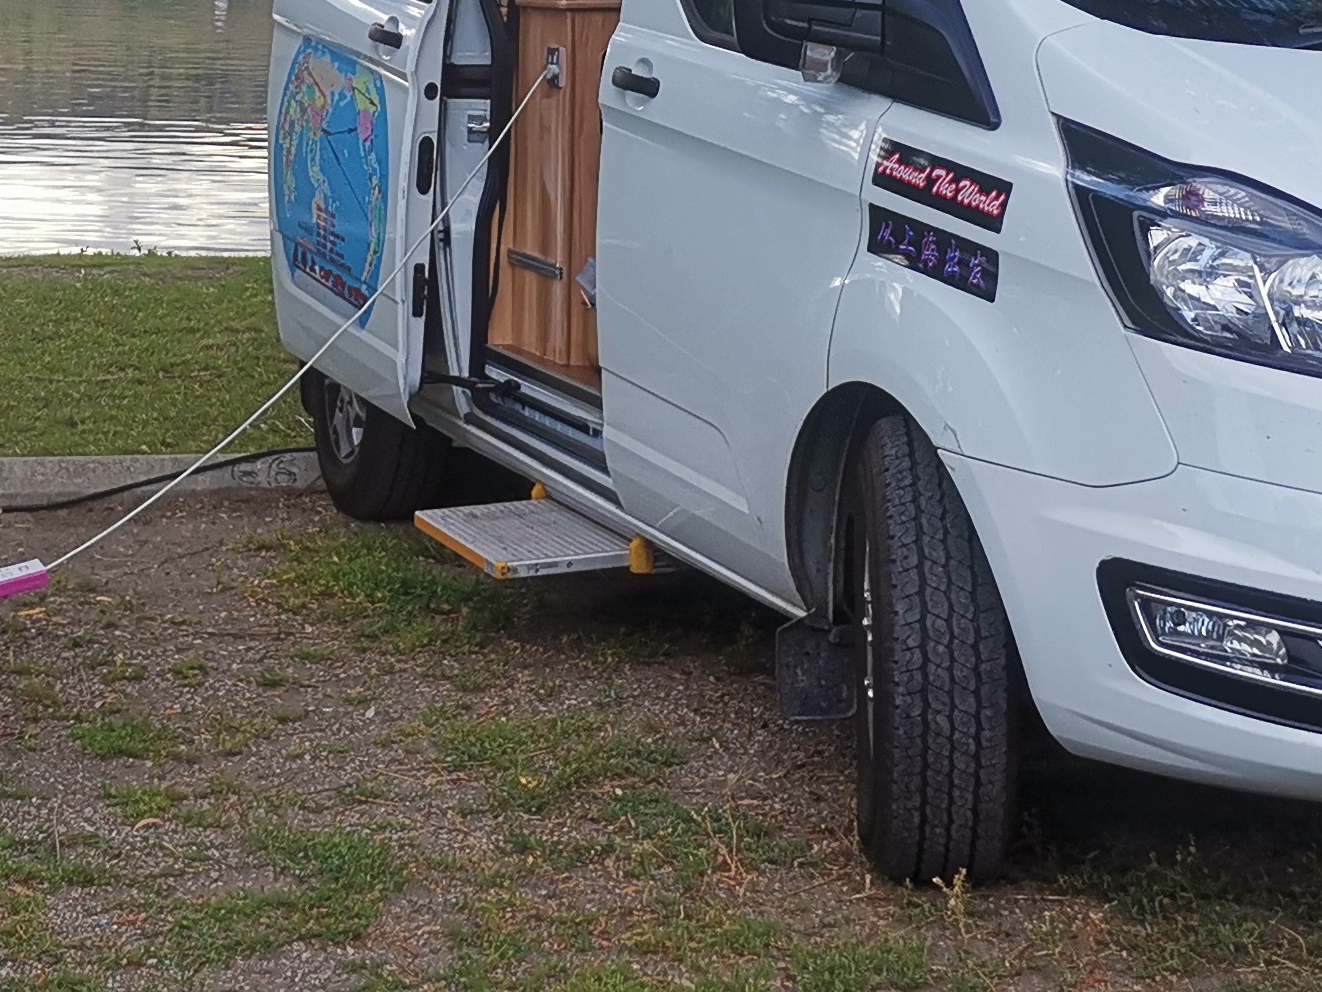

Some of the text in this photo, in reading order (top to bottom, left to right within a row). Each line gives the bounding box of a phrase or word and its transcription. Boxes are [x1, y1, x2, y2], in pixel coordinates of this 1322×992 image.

[877, 152, 1006, 217] Around The World
